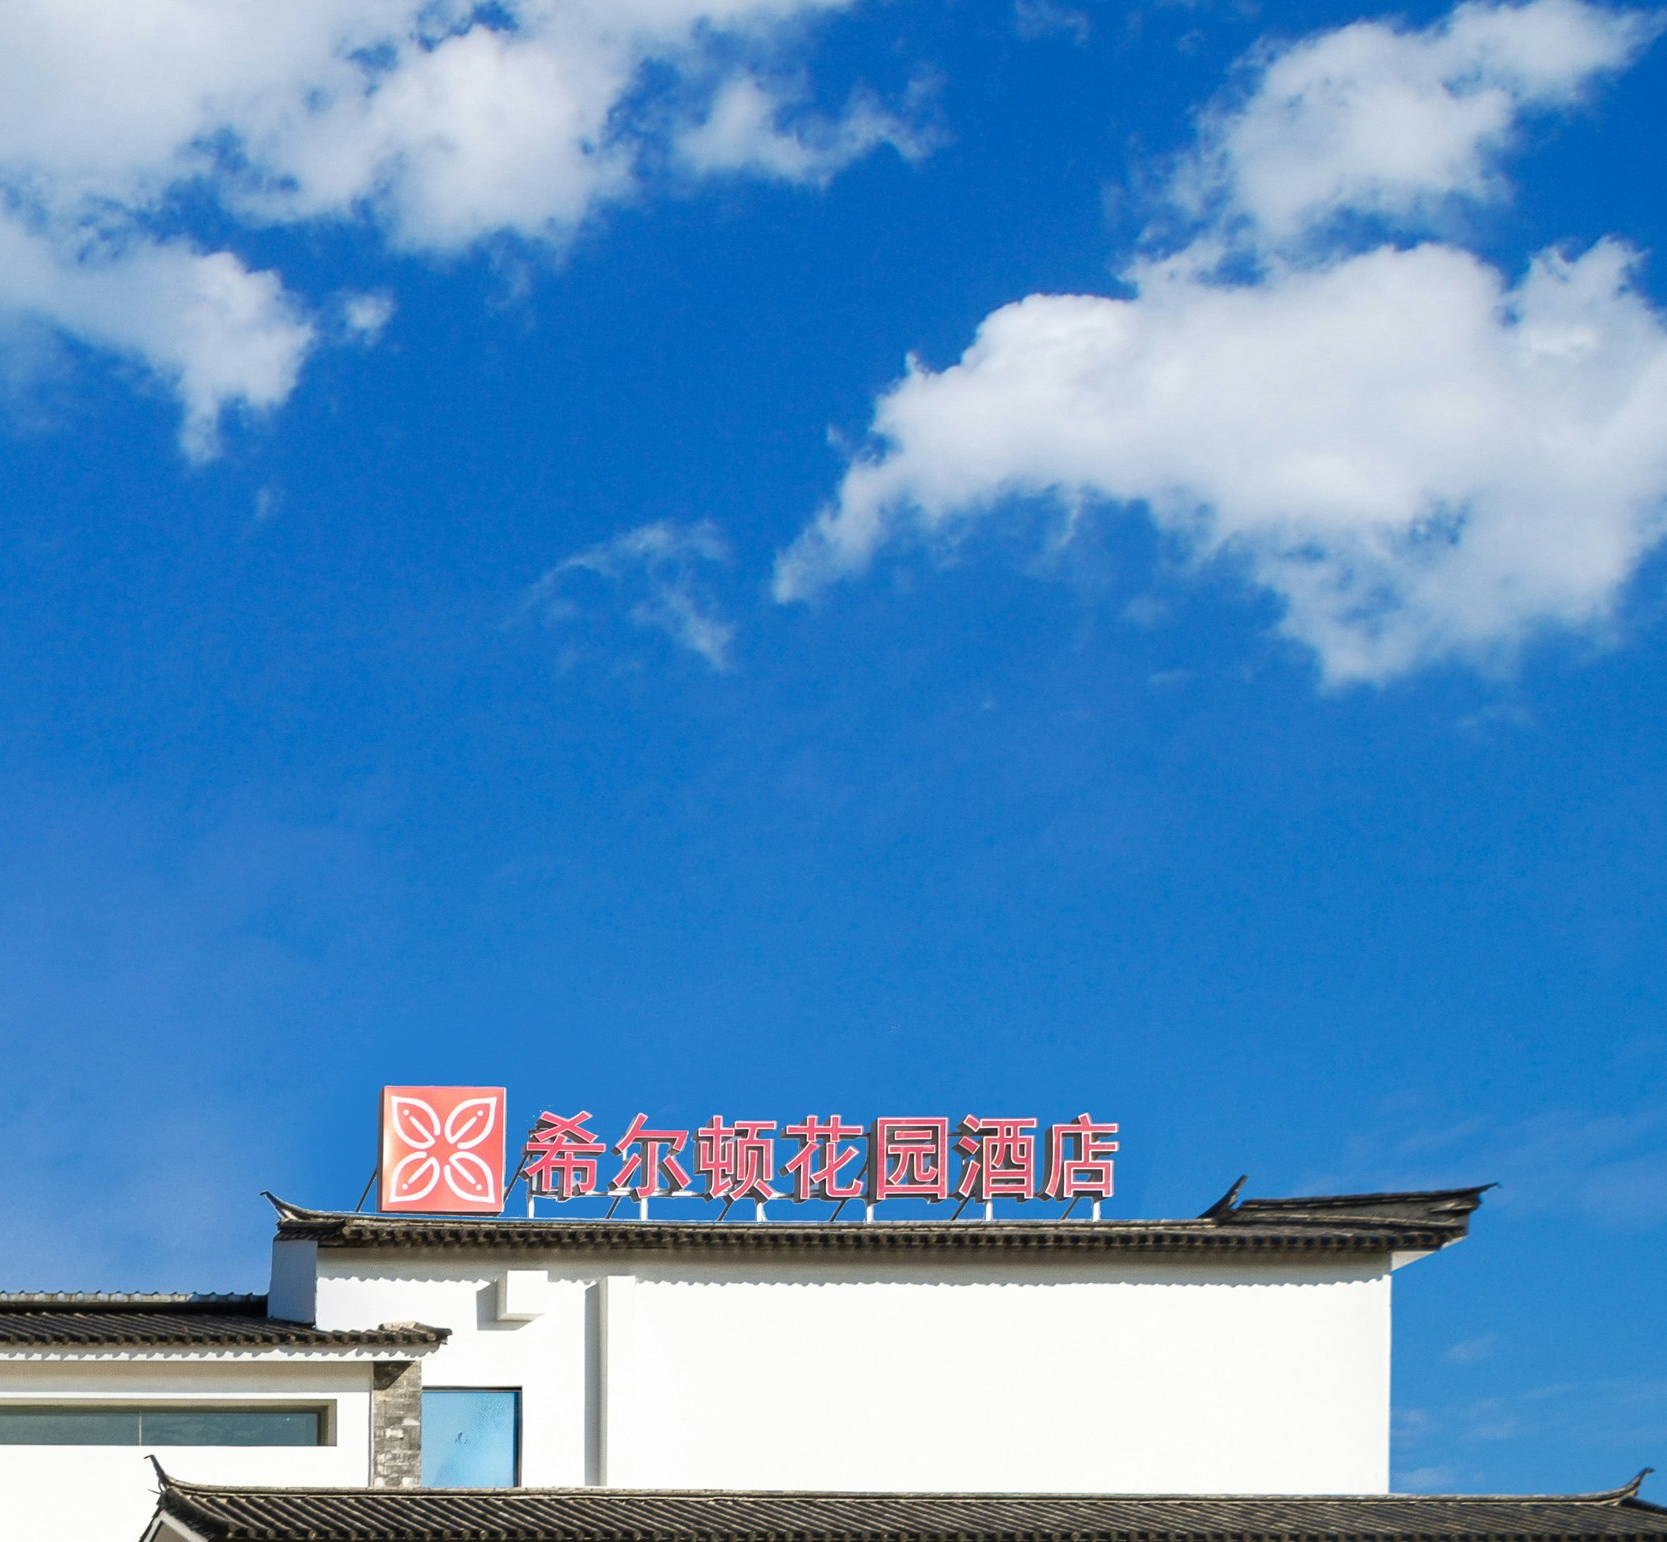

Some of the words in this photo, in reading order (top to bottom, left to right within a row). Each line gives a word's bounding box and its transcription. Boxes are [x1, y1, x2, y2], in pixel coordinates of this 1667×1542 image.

[524, 1110, 1119, 1201] 希尔顿花园酒店
